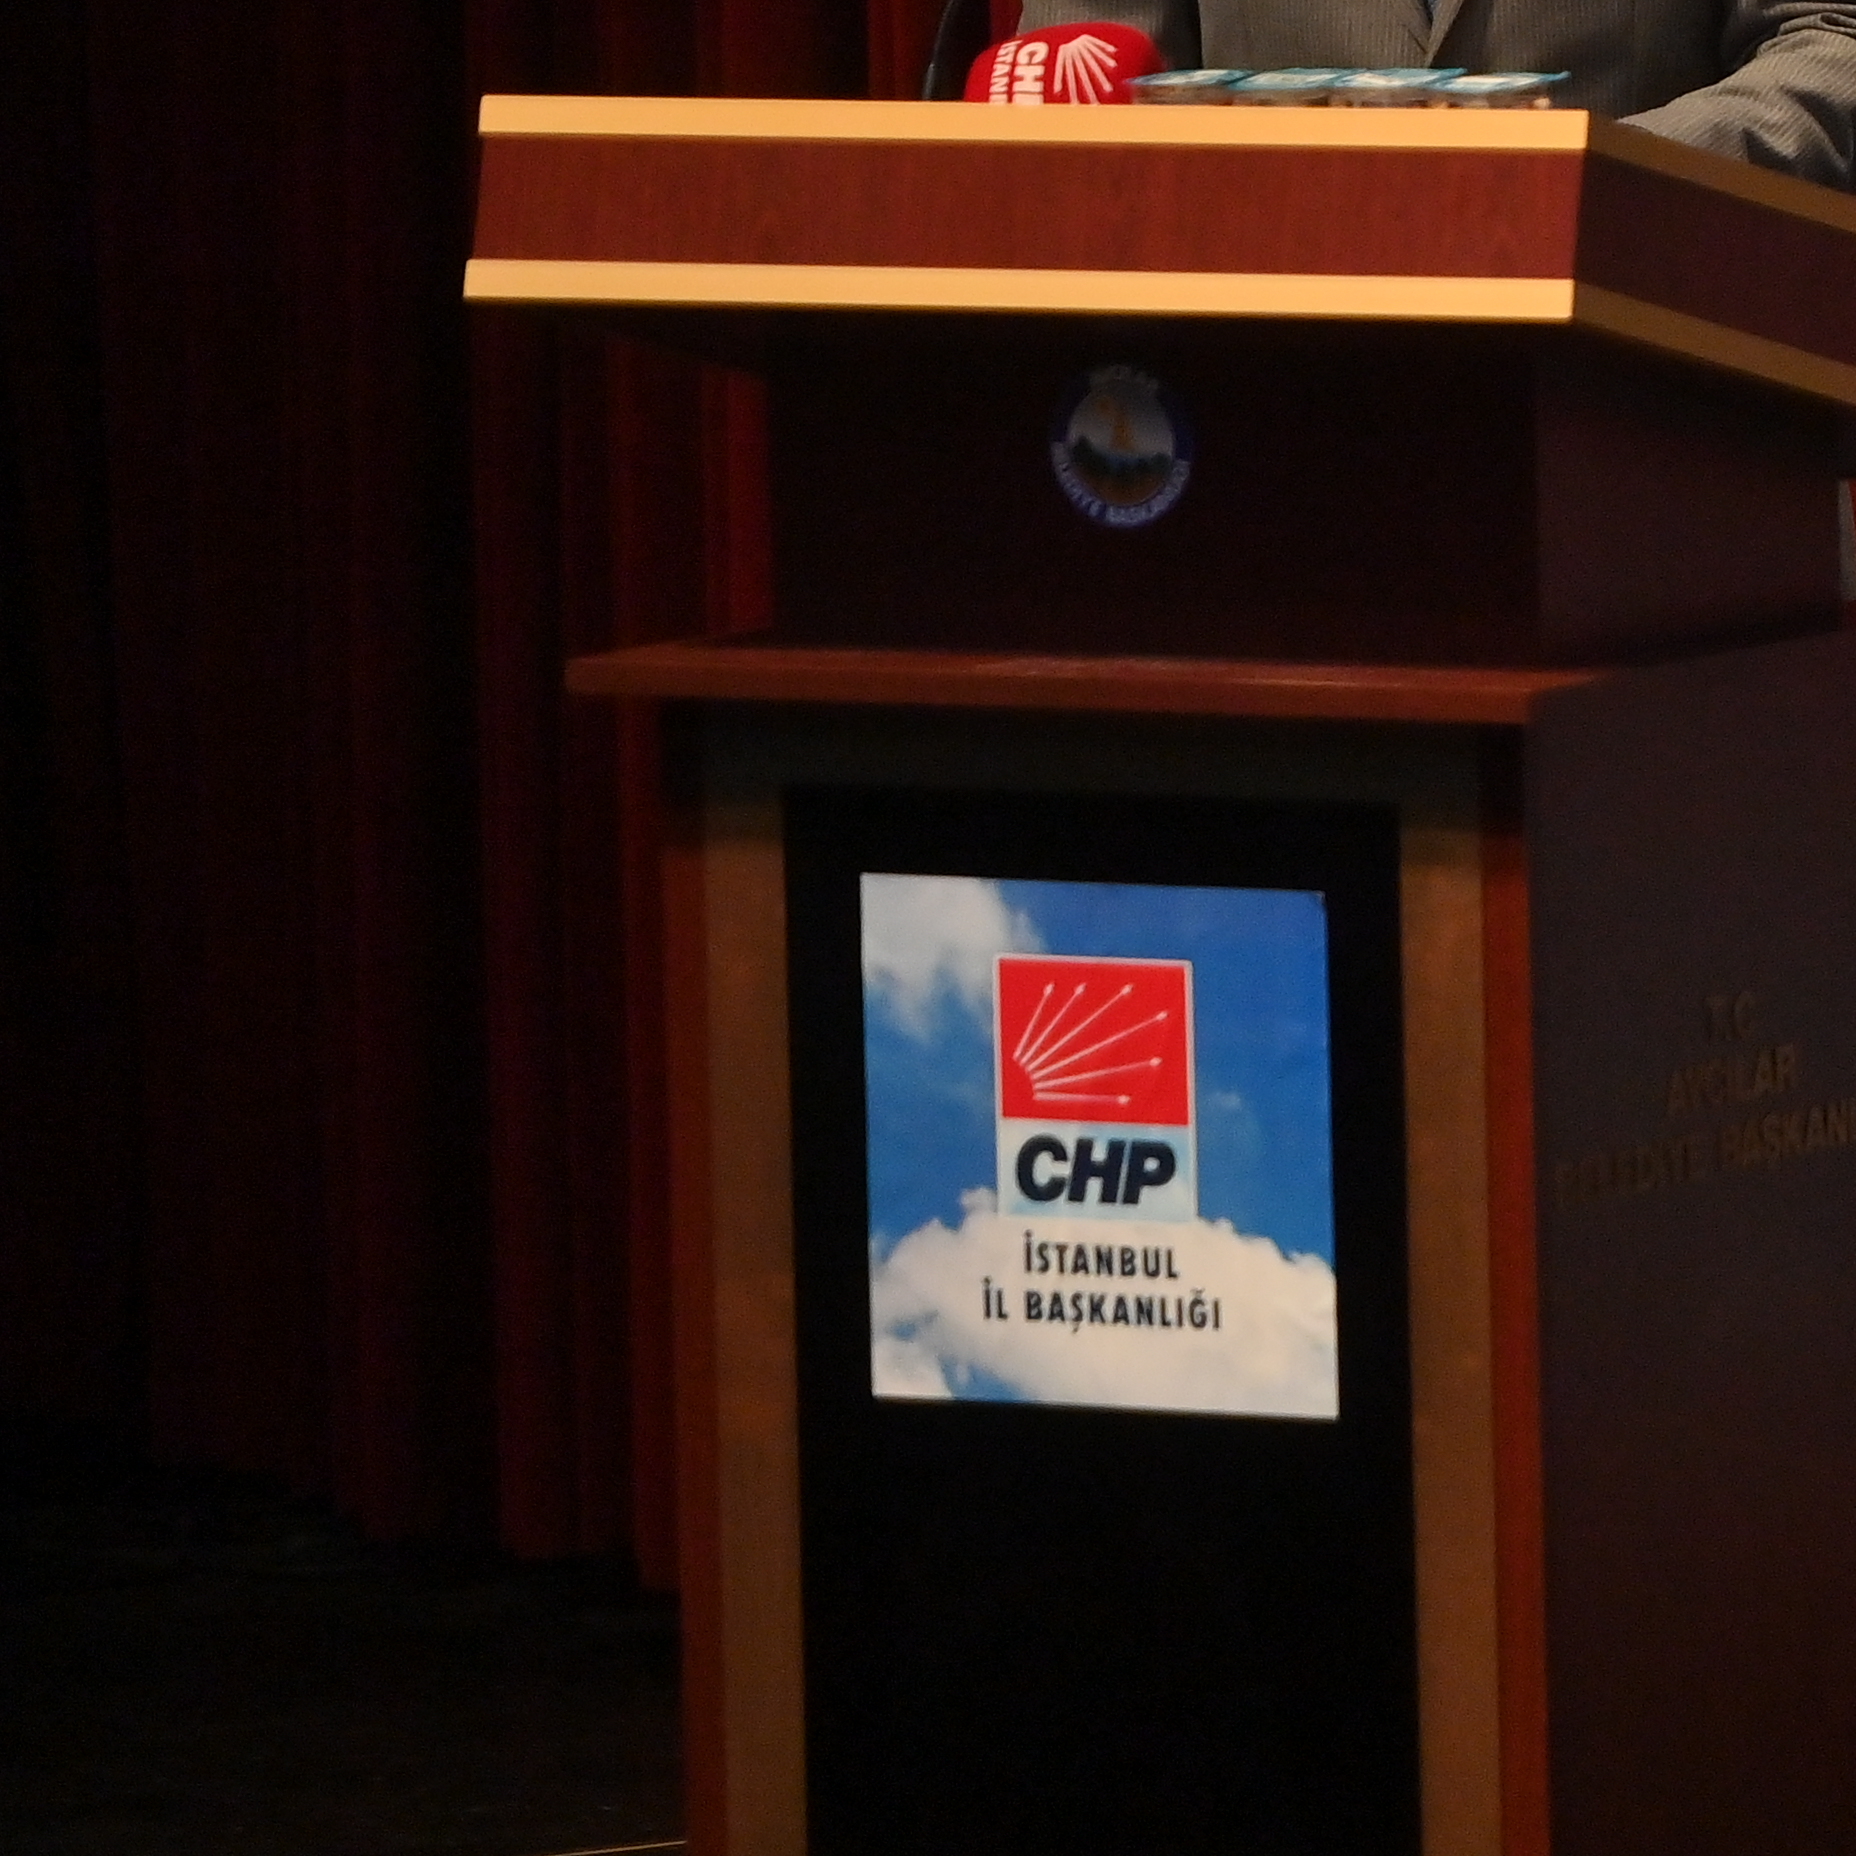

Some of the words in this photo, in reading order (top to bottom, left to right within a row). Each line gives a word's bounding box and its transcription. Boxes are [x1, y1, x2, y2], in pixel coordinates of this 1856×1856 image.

[1017, 1135, 1176, 1205] CHP
[1024, 1229, 1179, 1278] İSTANBUL
[983, 1277, 1008, 1320] İL
[1026, 1289, 1221, 1334] BAŞKANLIĞI
